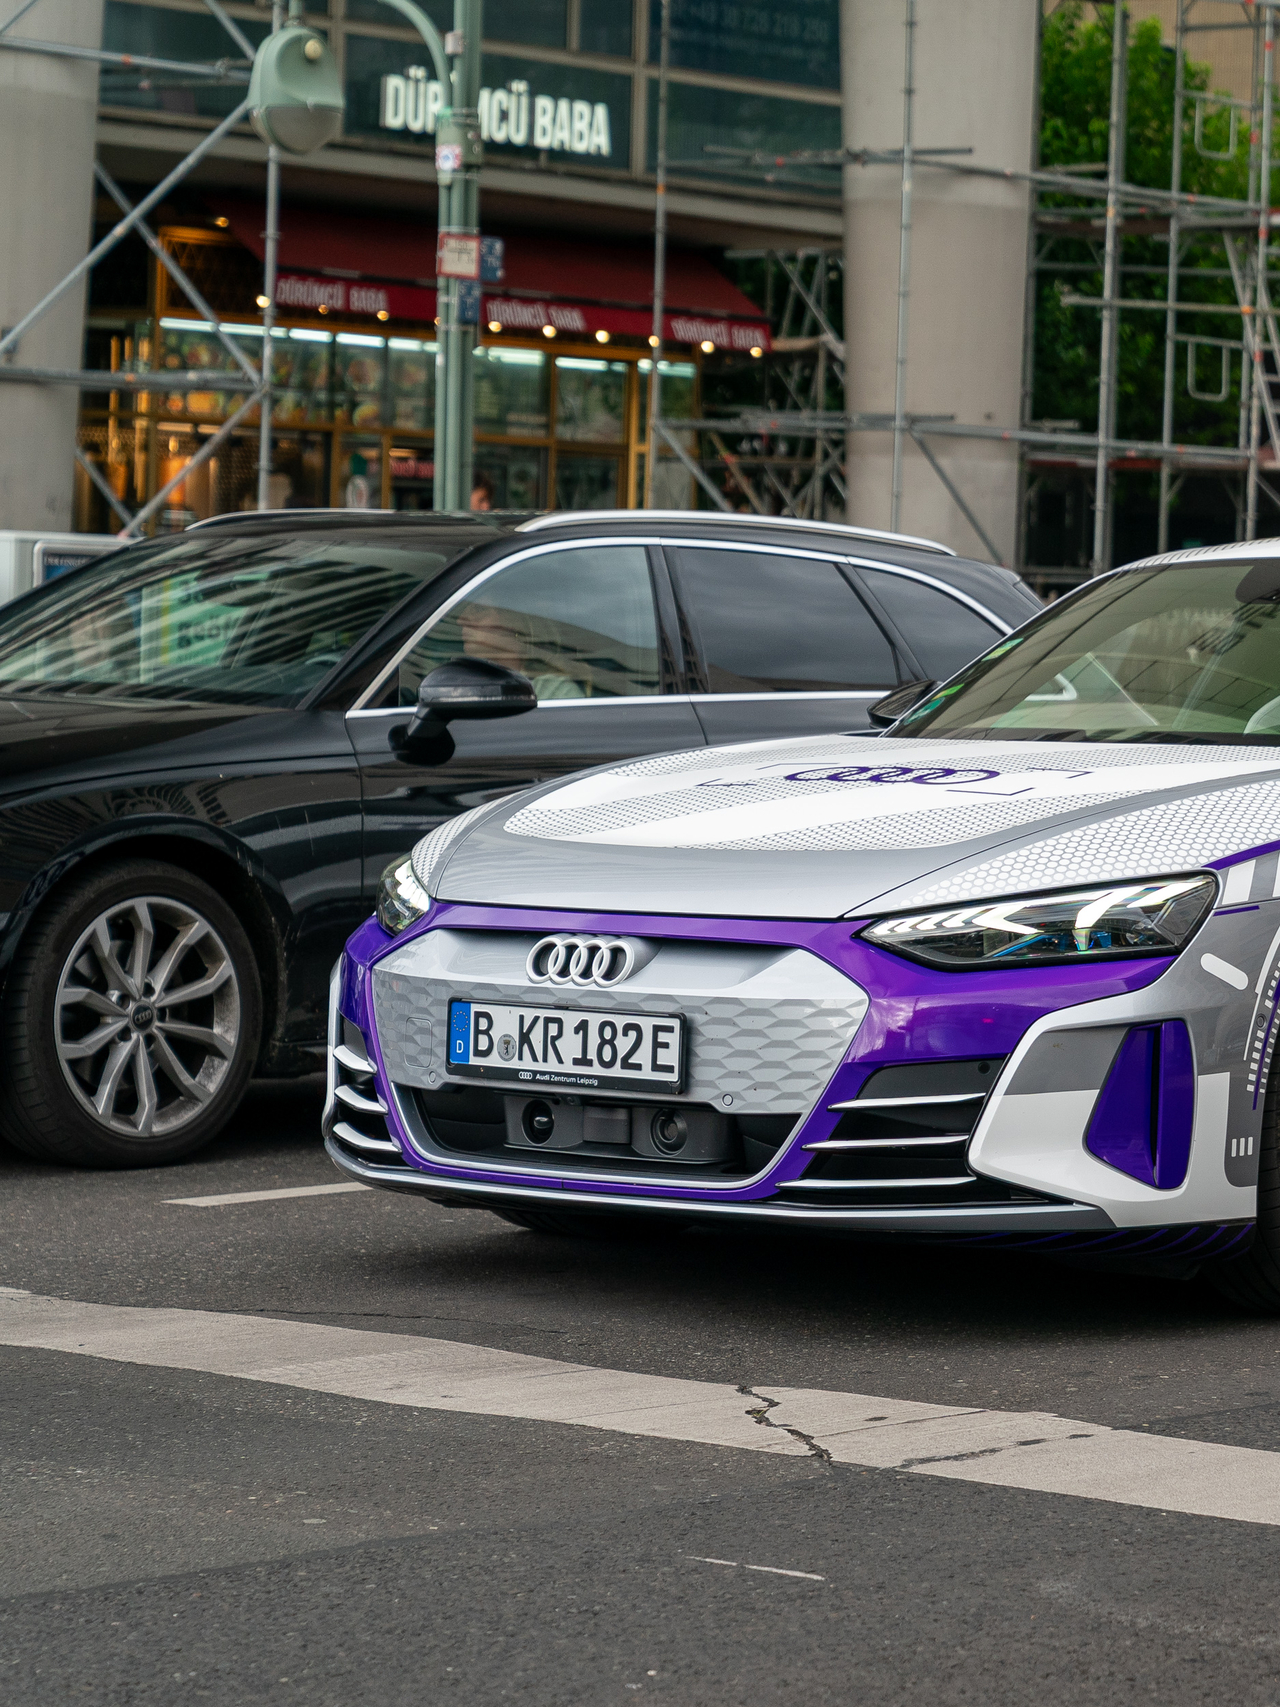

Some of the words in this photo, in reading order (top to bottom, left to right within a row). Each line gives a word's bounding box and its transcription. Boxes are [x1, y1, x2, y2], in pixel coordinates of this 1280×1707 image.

[382, 65, 529, 146] DÜRCÜ
[534, 94, 612, 157] BABA
[456, 1040, 464, 1054] D
[472, 1010, 494, 1058] B
[535, 1073, 550, 1081] Audi
[550, 1074, 576, 1083] Zentrum
[577, 1076, 598, 1087] Leipzig
